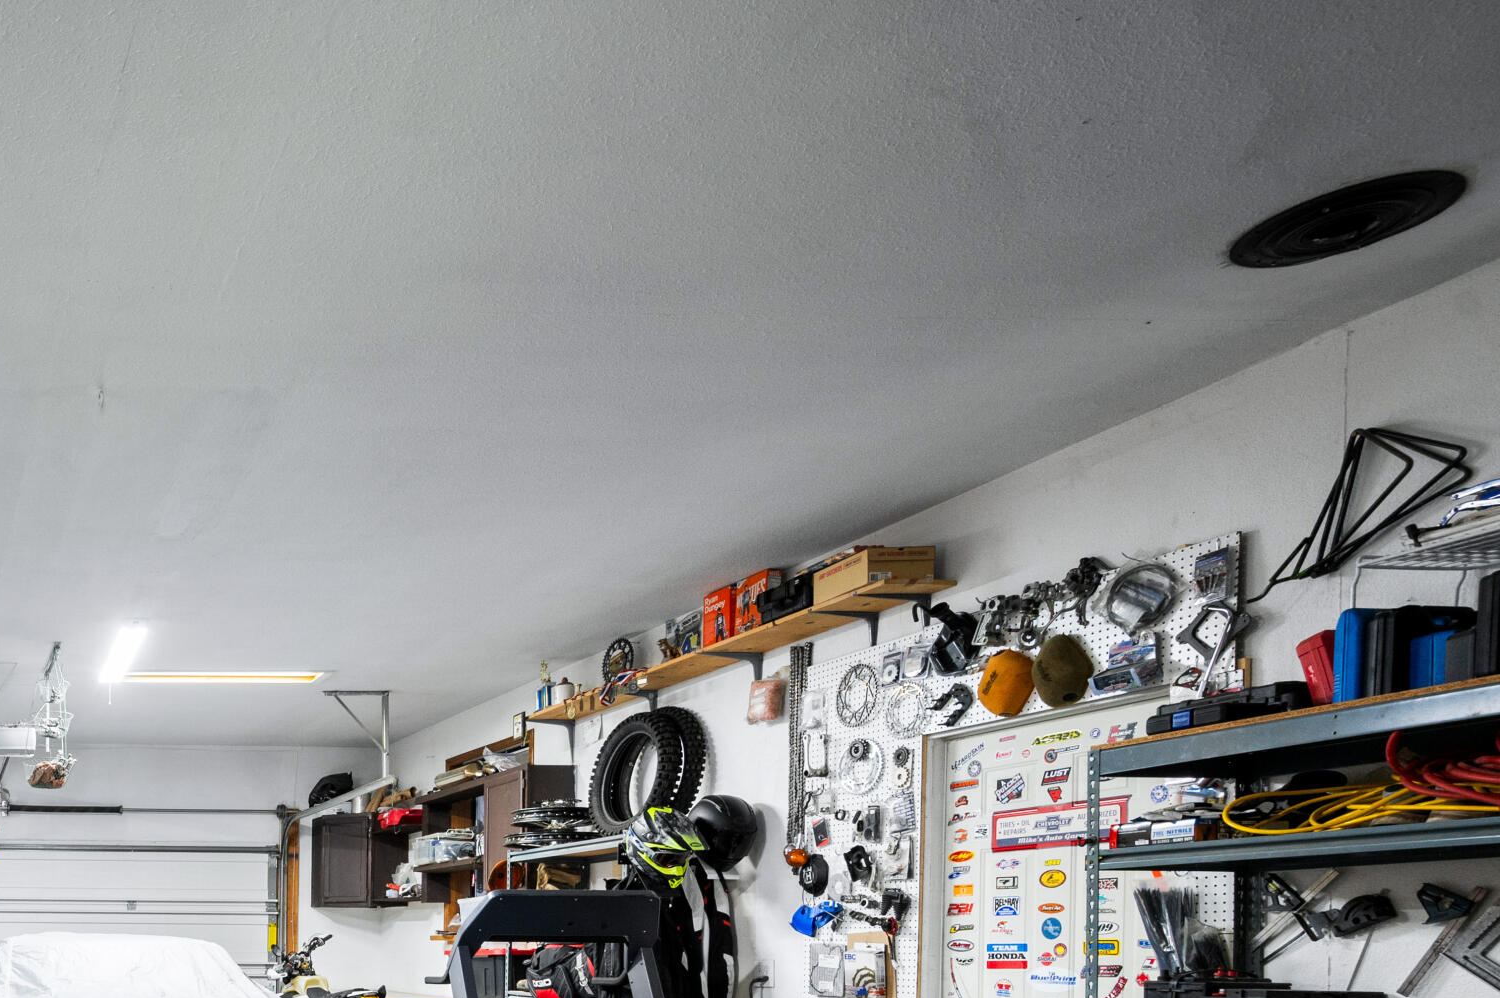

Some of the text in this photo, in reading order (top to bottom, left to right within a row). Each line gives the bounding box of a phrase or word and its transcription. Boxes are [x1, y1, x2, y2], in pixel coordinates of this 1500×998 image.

[704, 595, 719, 606] Ryan
[704, 600, 726, 614] Dungey
[1044, 768, 1070, 778] LUST
[1077, 810, 1117, 820] AURIZED
[1037, 818, 1069, 827] CHEVROLET
[1166, 827, 1193, 836] NITRILE
[1018, 834, 1043, 843] Mike's
[1065, 833, 1088, 841] Garag
[844, 953, 857, 961] EBC
